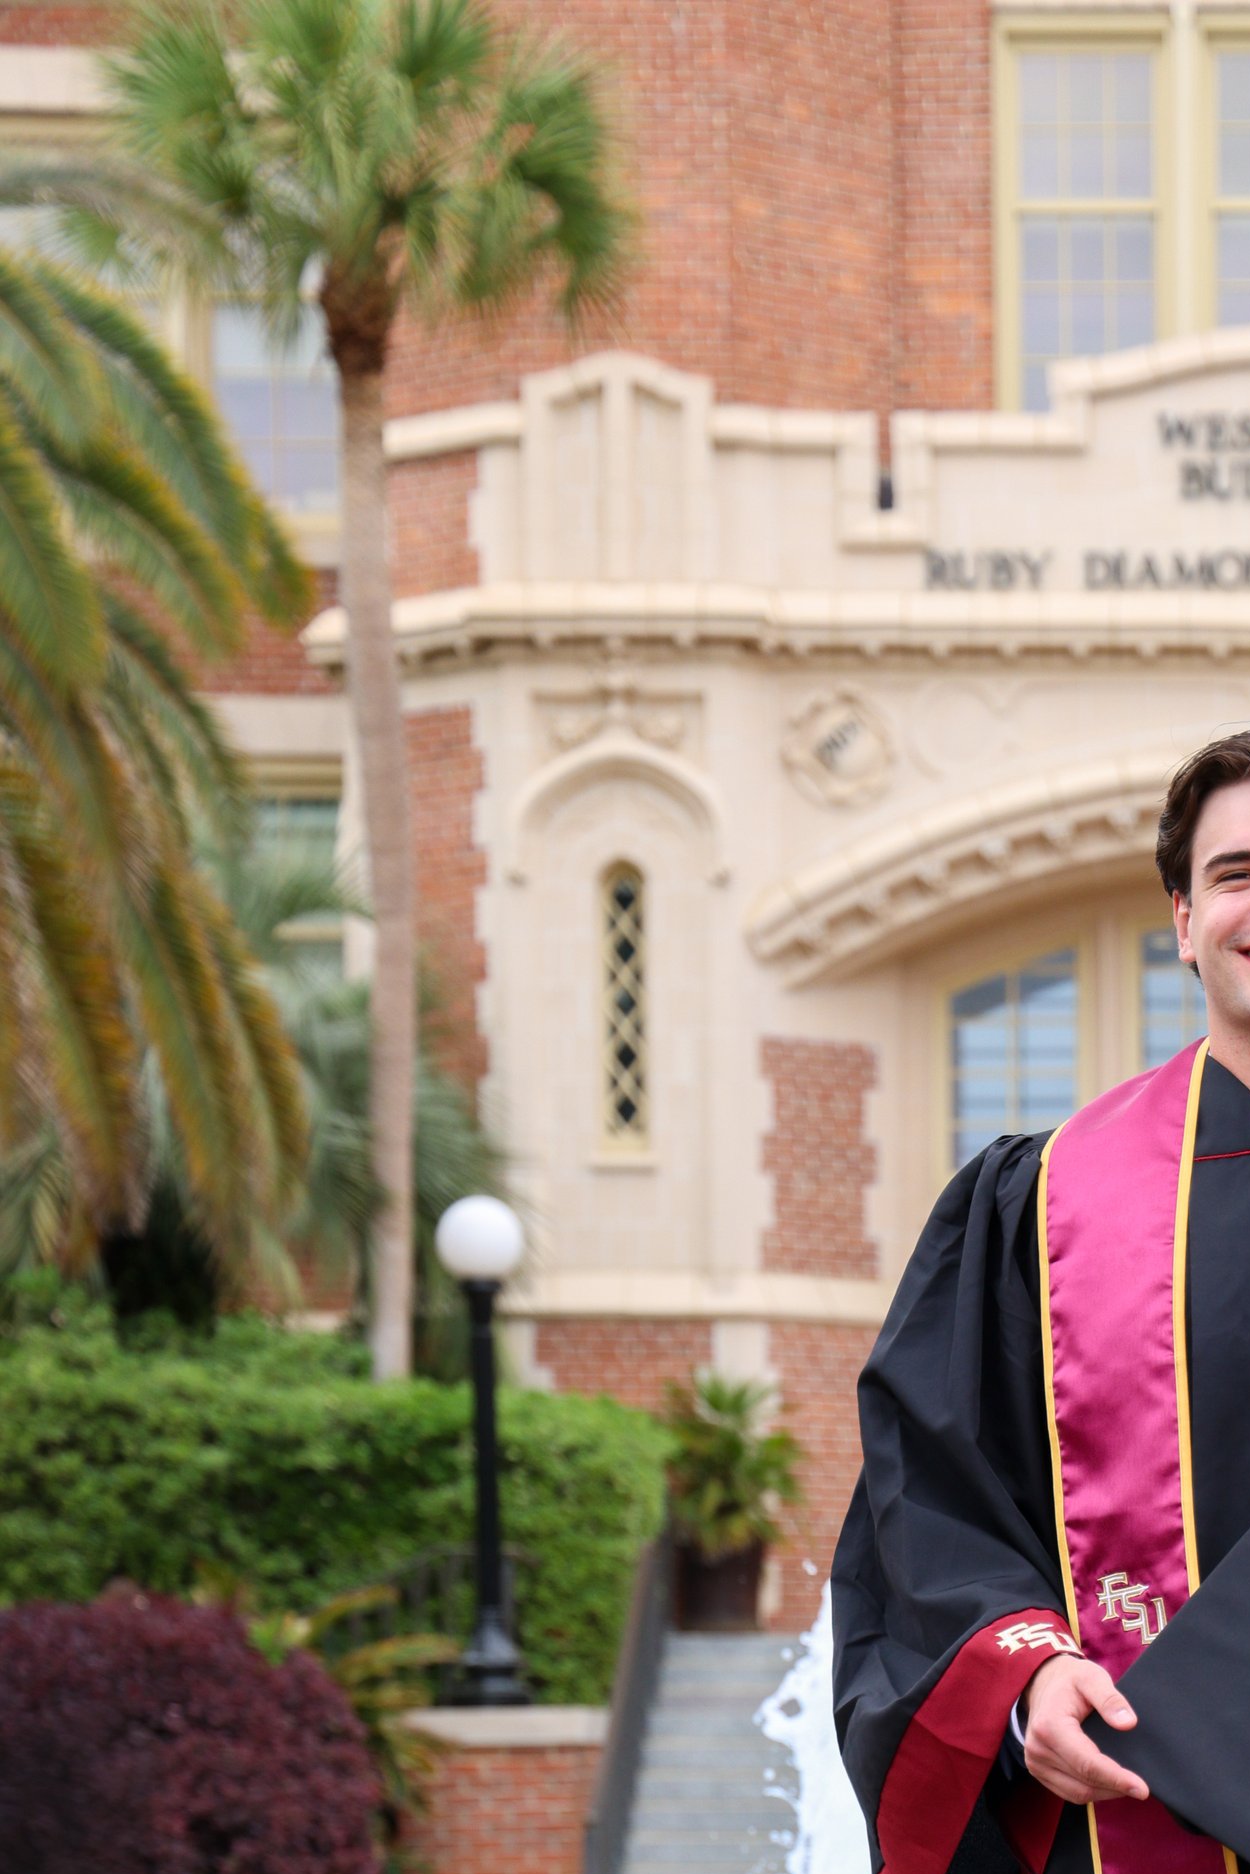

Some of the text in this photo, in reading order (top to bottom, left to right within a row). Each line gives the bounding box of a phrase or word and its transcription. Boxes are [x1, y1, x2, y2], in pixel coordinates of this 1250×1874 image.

[924, 549, 1051, 591] RUBY
[1097, 1571, 1168, 1645] FSU
[993, 1622, 1085, 1656] FSU
